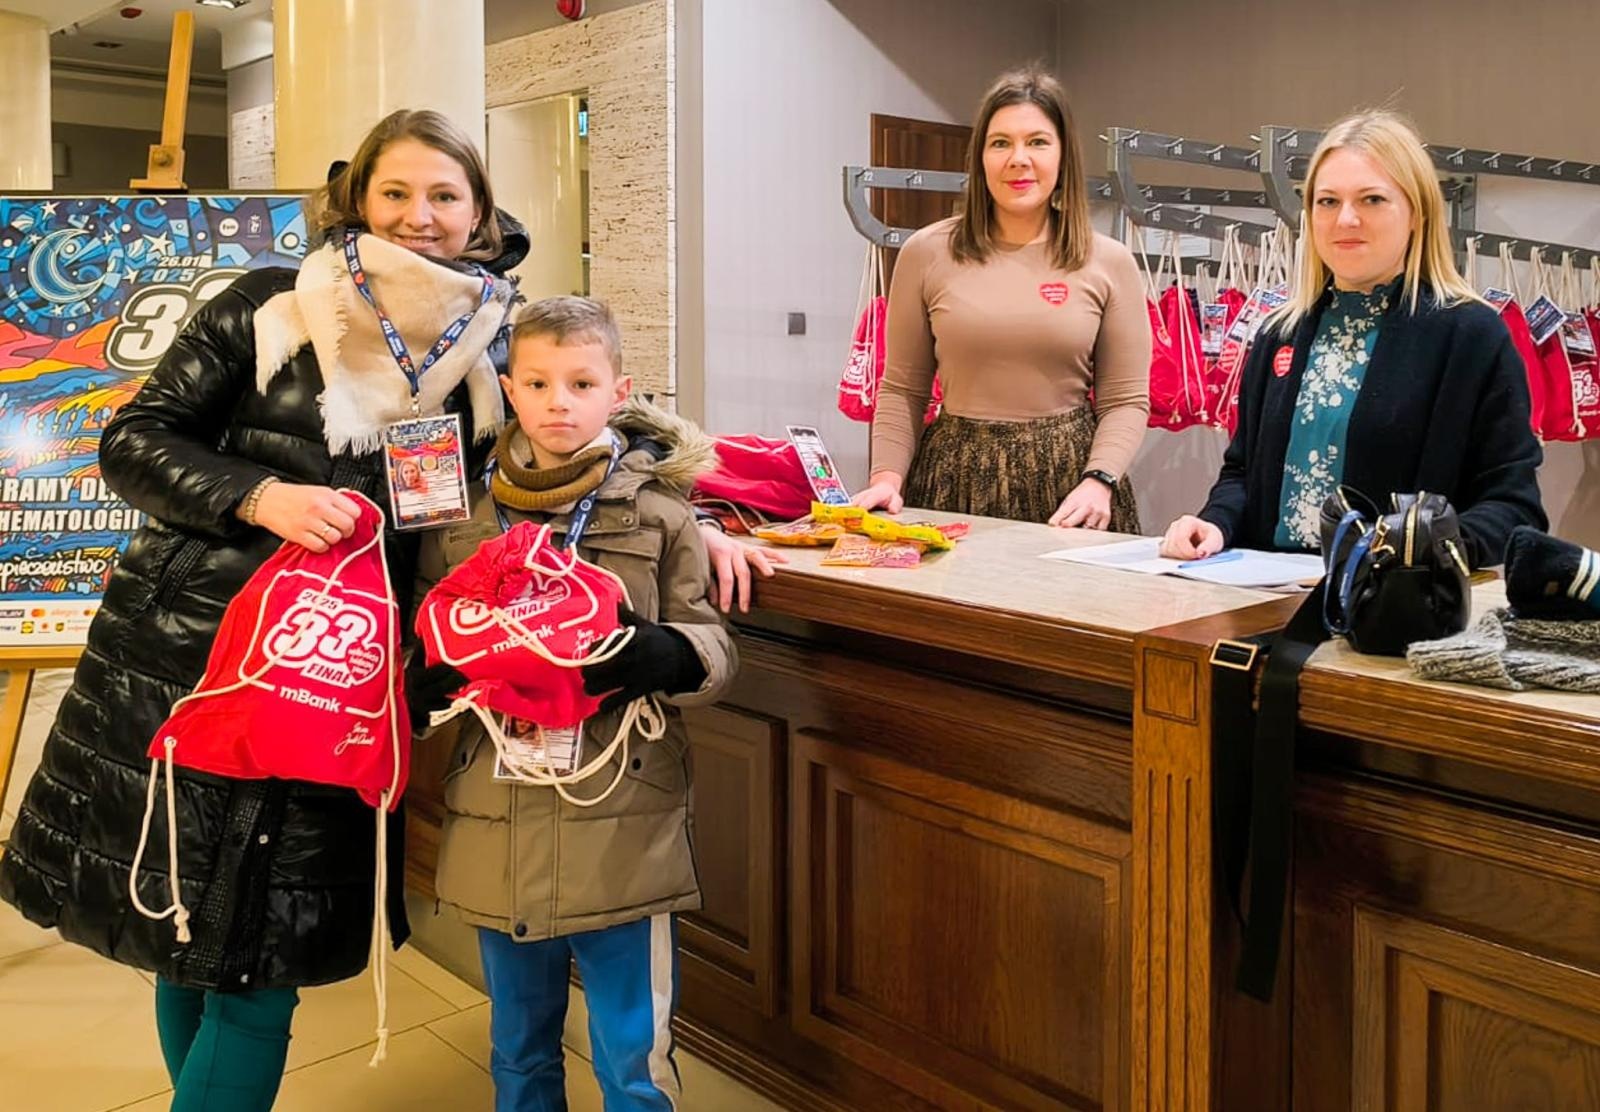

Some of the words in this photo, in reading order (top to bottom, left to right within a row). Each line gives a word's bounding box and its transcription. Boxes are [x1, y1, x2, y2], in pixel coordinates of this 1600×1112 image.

[158, 256, 199, 267] 26.01
[140, 268, 195, 282] 2025
[0, 477, 74, 501] RAMY
[0, 509, 140, 531] HEMATOLOGII
[0, 549, 107, 591] pieczeństwo
[273, 609, 368, 660] 33
[492, 624, 555, 654] mBnk
[306, 663, 353, 686] FINAL
[279, 685, 341, 713] mBank
